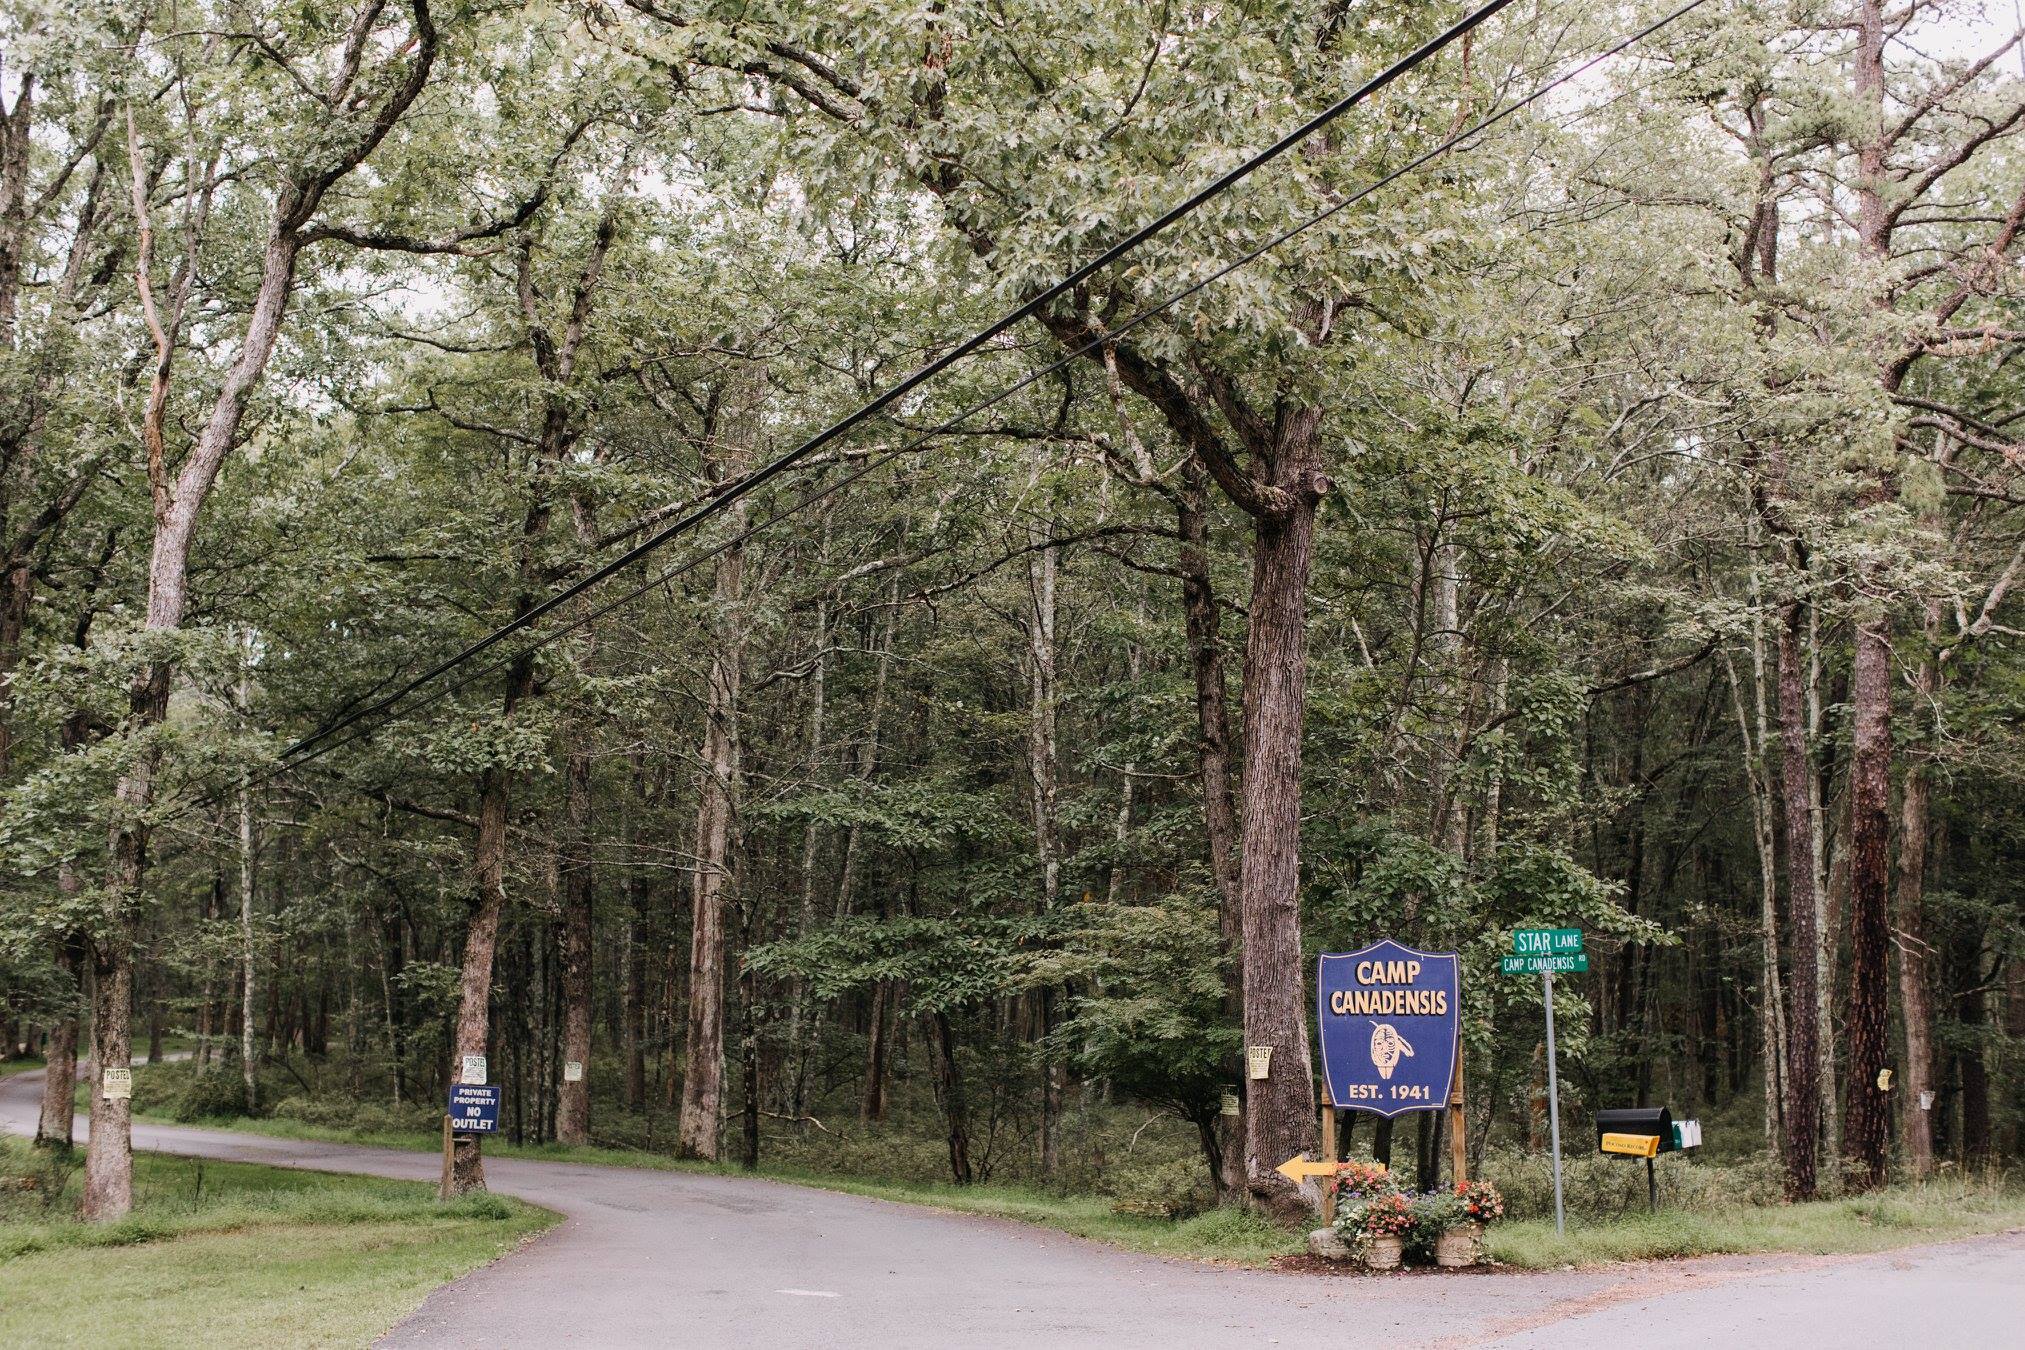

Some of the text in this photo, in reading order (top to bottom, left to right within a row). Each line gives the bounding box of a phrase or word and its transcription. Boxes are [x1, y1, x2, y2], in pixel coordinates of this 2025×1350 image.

[1518, 932, 1580, 952] STAR LANE
[1504, 957, 1525, 971] CAMP
[1527, 956, 1575, 971] CANADENSIS
[1356, 960, 1421, 985] CAMP
[1330, 990, 1448, 1016] CANADENSIS
[458, 1088, 492, 1097] PRIVATE
[1349, 1084, 1430, 1100] EST. 1941
[453, 1096, 496, 1106] PROPERTY
[466, 1106, 482, 1117] NO
[452, 1118, 494, 1130] OUTLET
